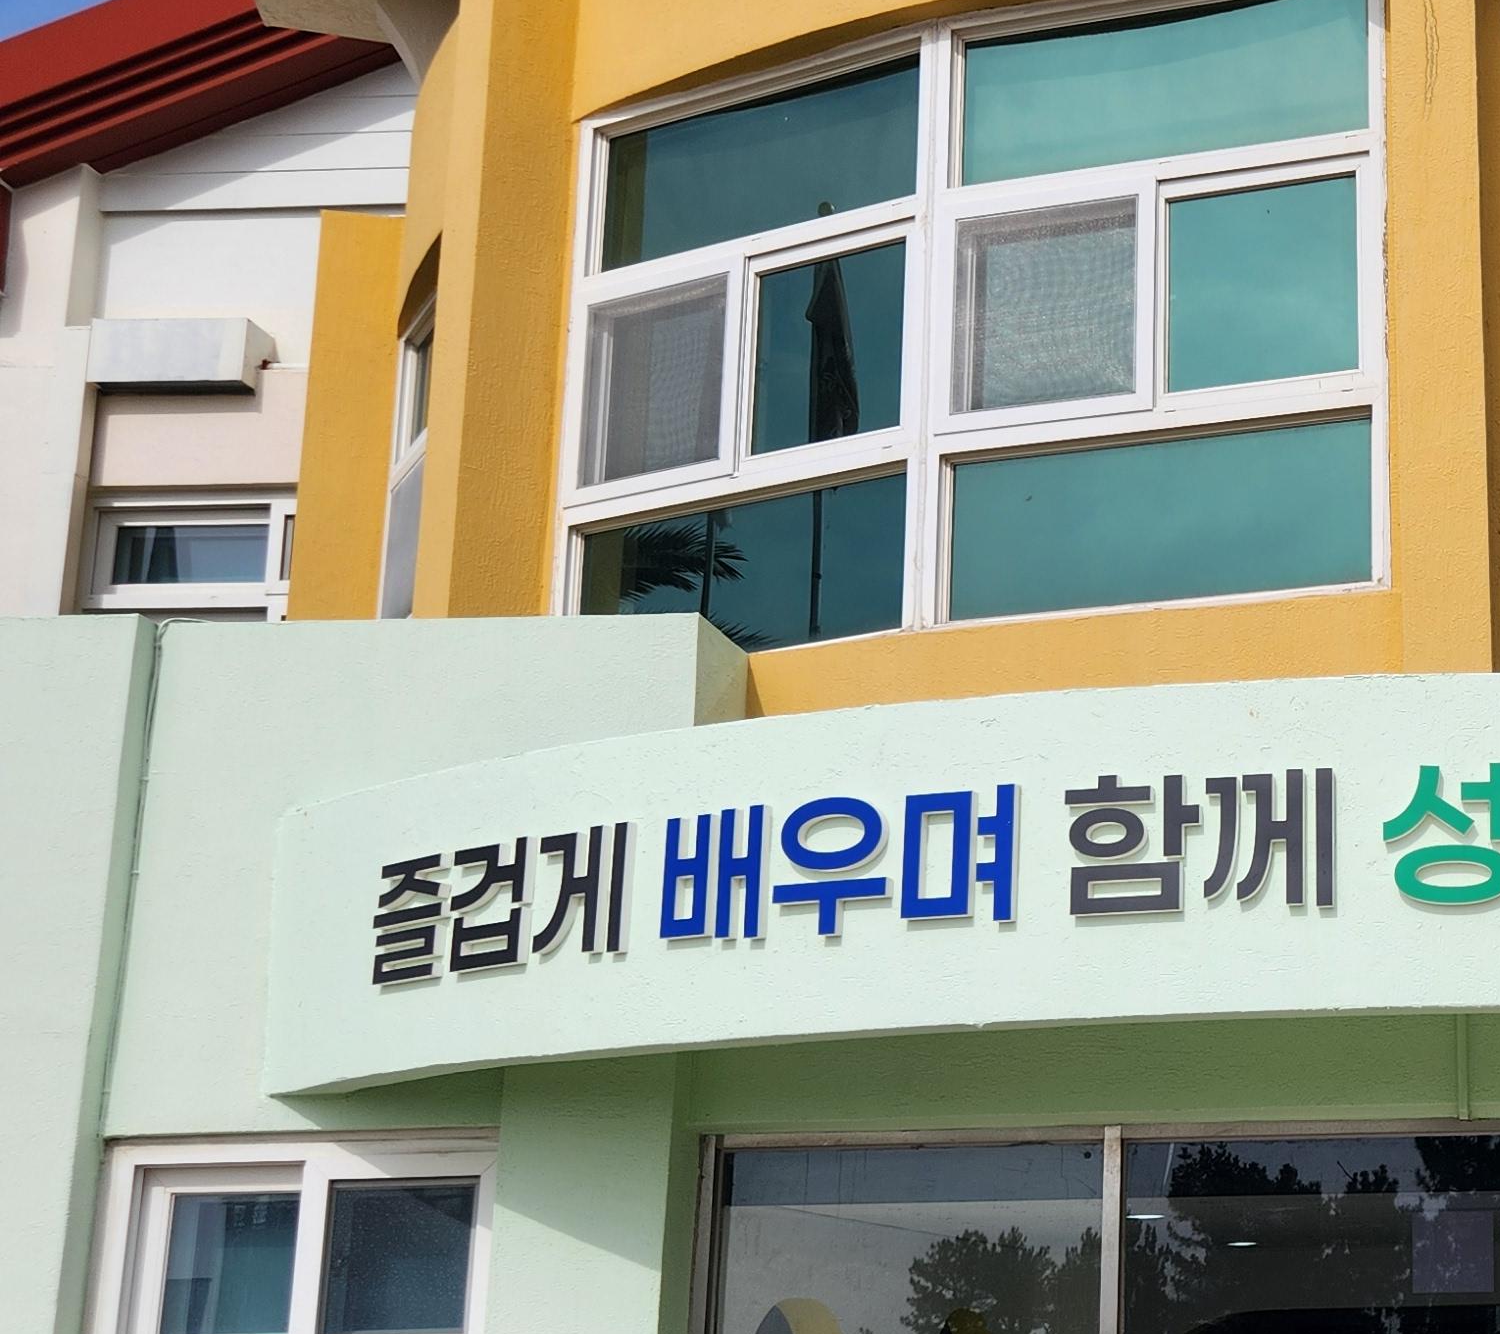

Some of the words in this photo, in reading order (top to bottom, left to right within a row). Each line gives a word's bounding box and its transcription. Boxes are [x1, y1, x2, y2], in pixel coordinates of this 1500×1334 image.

[371, 820, 636, 987] 즐겁게
[659, 782, 1020, 942] 배우며
[1063, 766, 1334, 918] 함께
